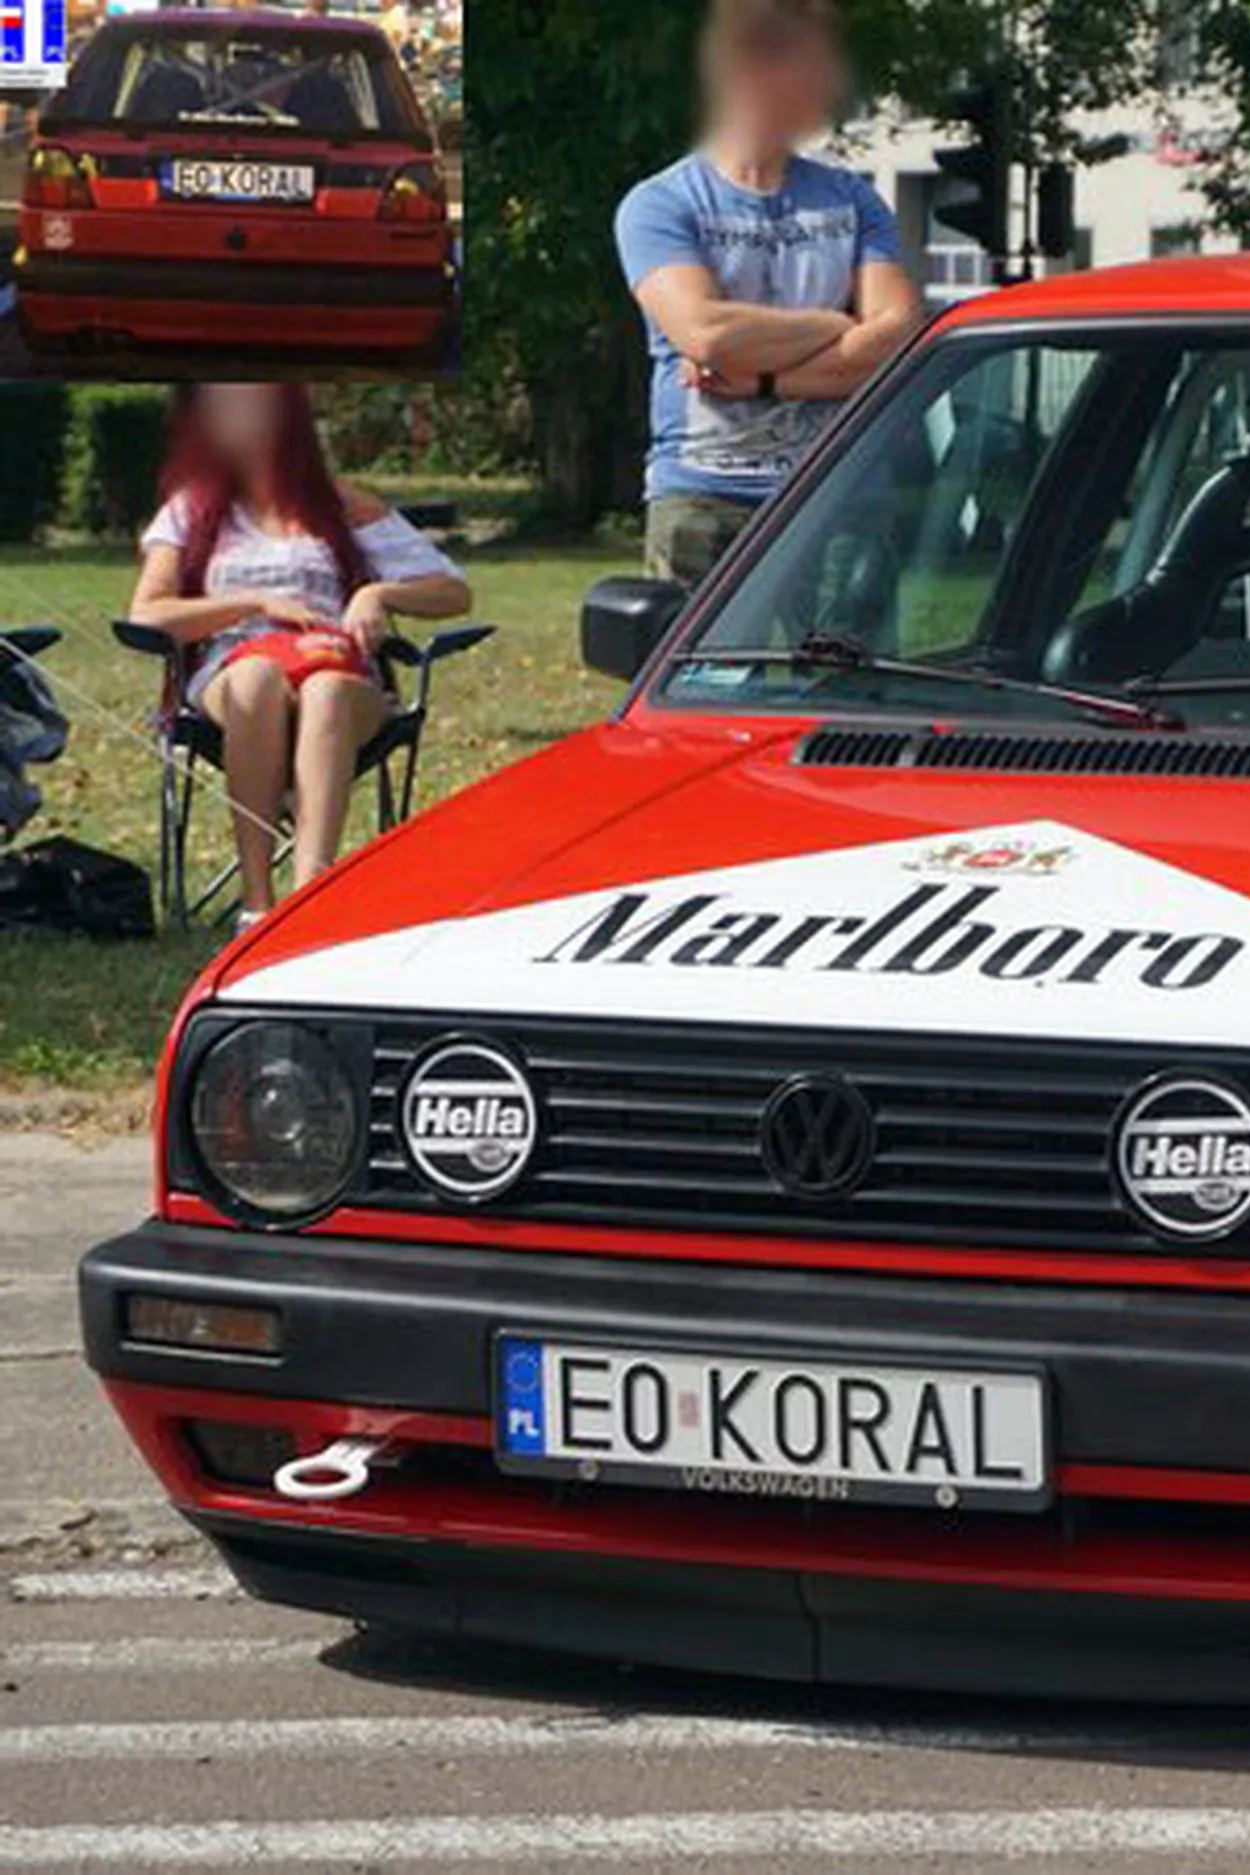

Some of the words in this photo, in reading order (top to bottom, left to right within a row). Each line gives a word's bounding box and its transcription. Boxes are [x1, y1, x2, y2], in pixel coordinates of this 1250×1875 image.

[532, 882, 1244, 990] Marlboro
[414, 1096, 525, 1136] Hella
[508, 1407, 541, 1438] PL
[707, 1366, 1025, 1480] KORAL
[680, 1467, 851, 1499] VOLKSWAGEN
